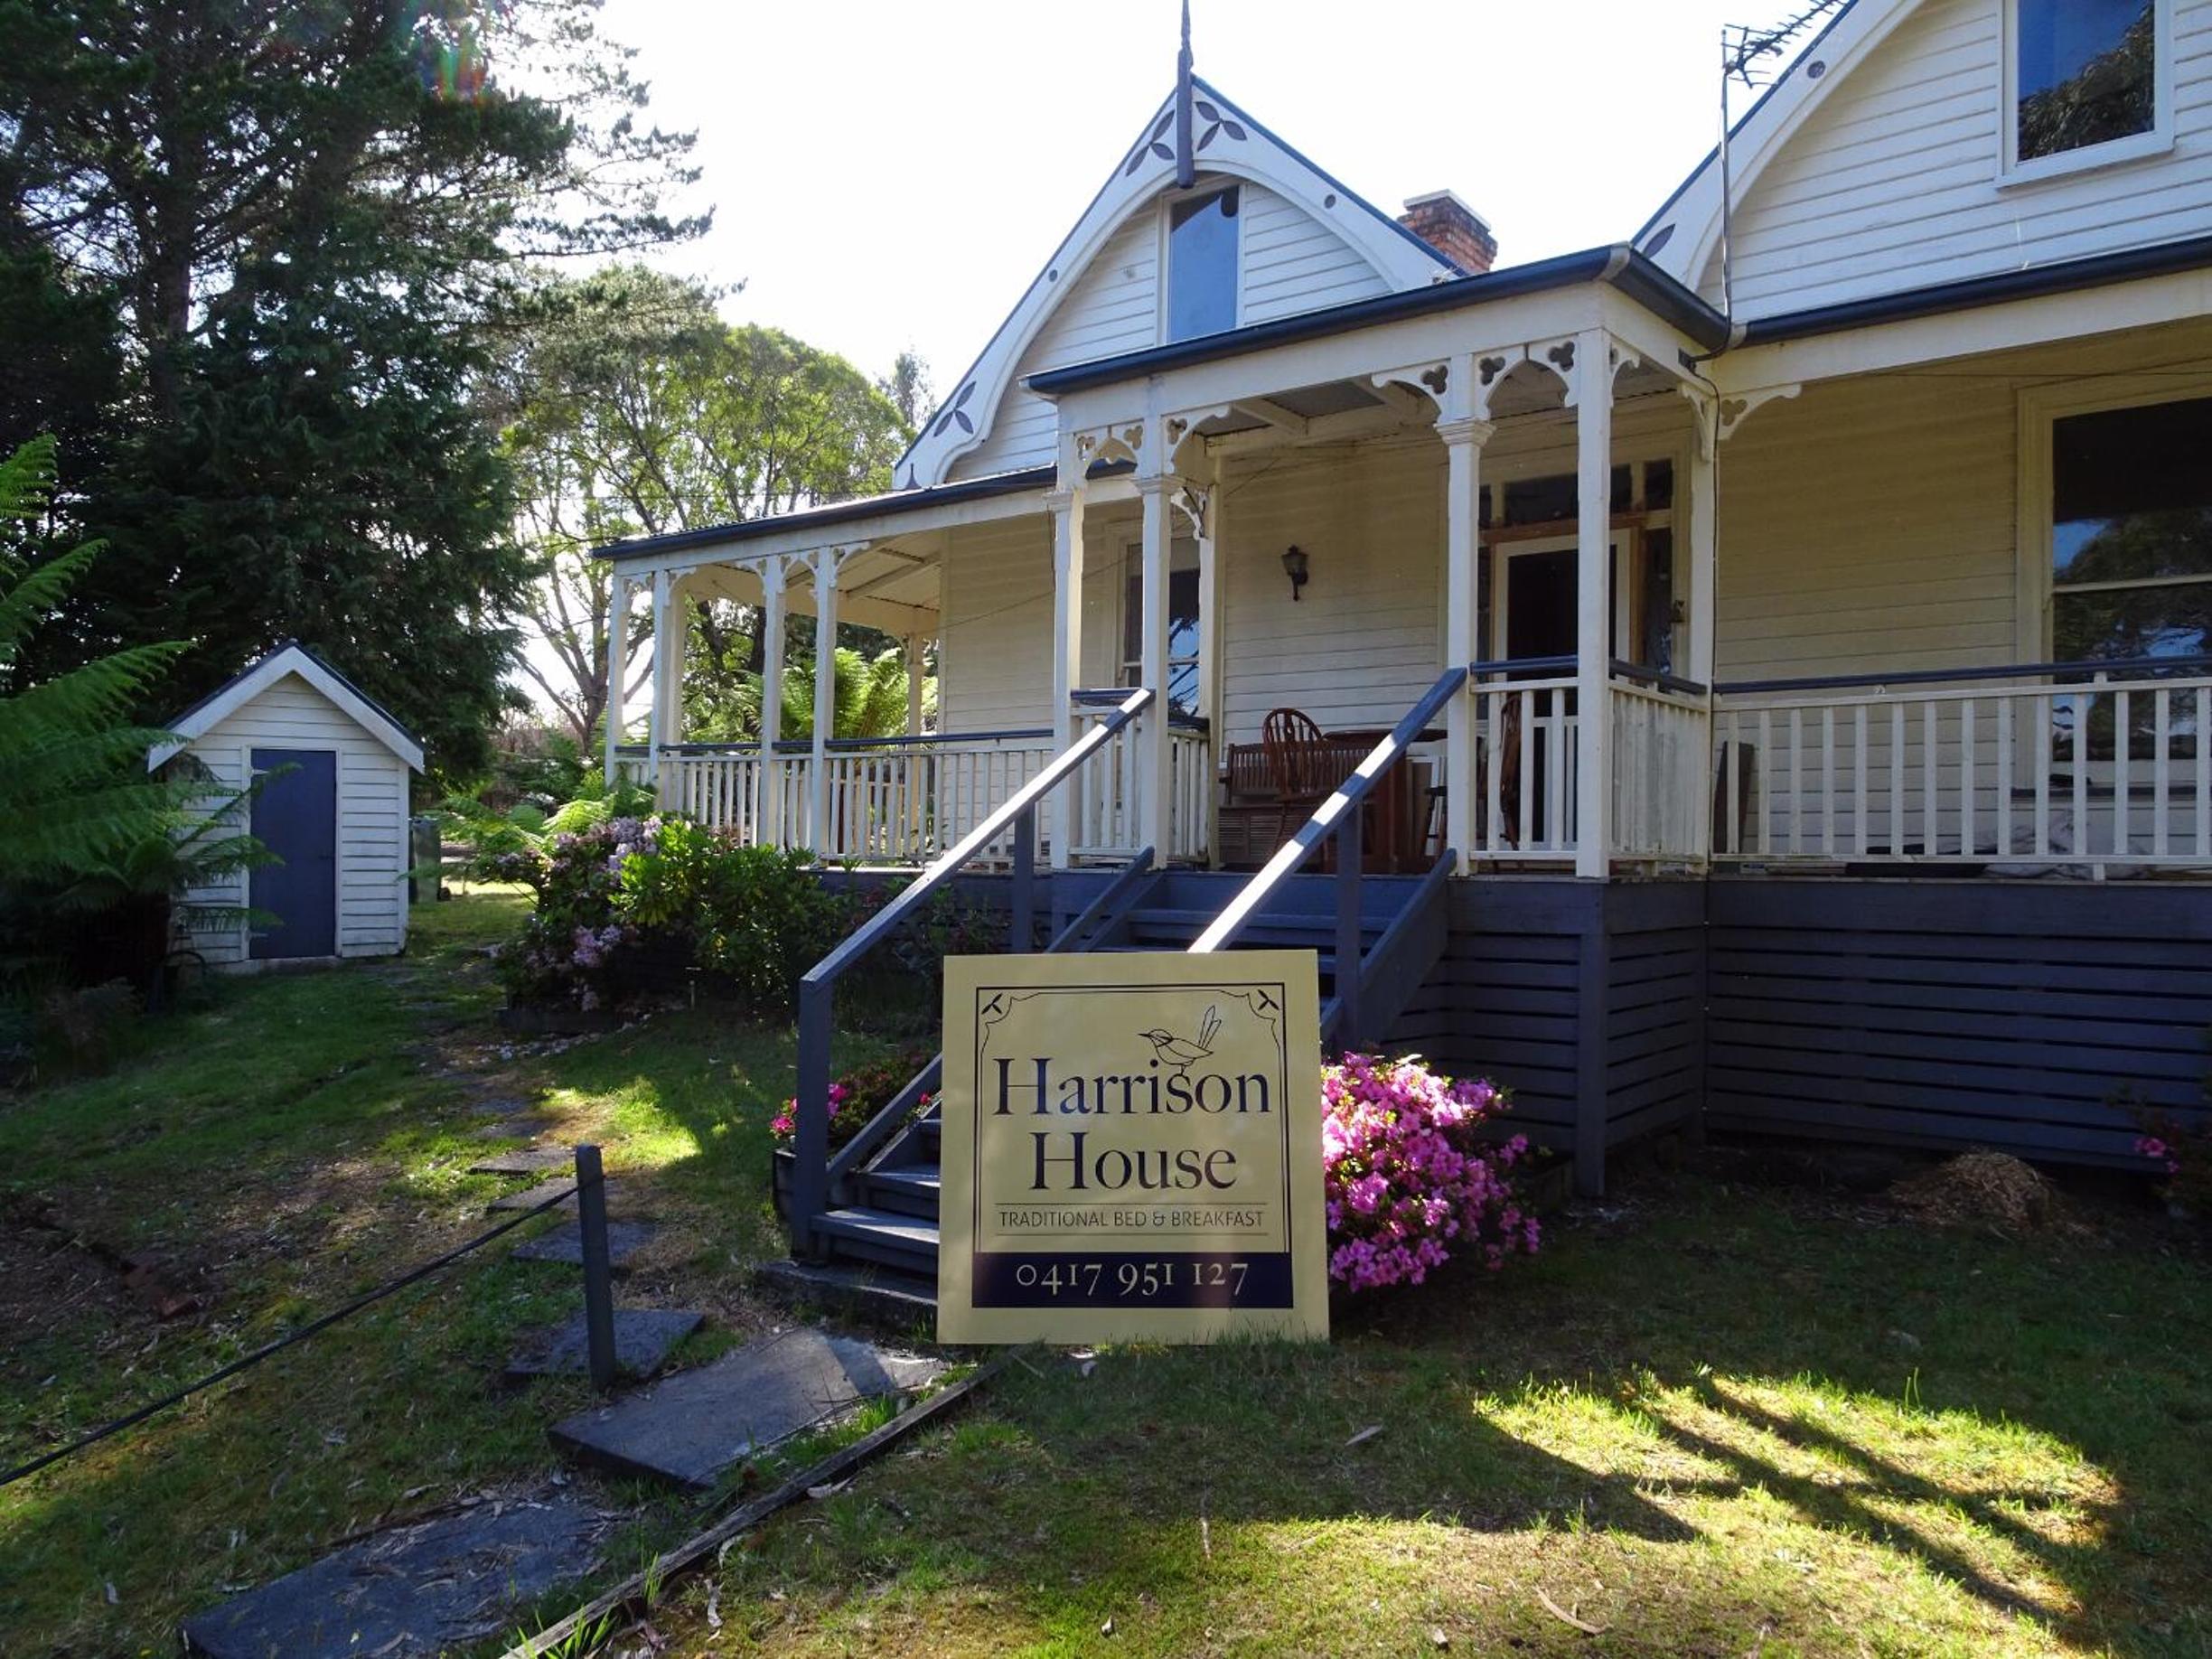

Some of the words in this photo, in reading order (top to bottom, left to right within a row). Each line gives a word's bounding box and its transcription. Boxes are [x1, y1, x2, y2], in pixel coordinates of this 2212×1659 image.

[992, 1057, 1271, 1116] Harrison
[1028, 1131, 1237, 1190] House
[998, 1211, 1108, 1228] TRADITIONAL
[1113, 1211, 1147, 1226] BED
[1152, 1213, 1167, 1226] &
[1171, 1211, 1263, 1227] BREAKFAST
[1016, 1264, 1101, 1296] 0417
[1118, 1263, 1173, 1297] 951
[1193, 1263, 1248, 1296] 127
